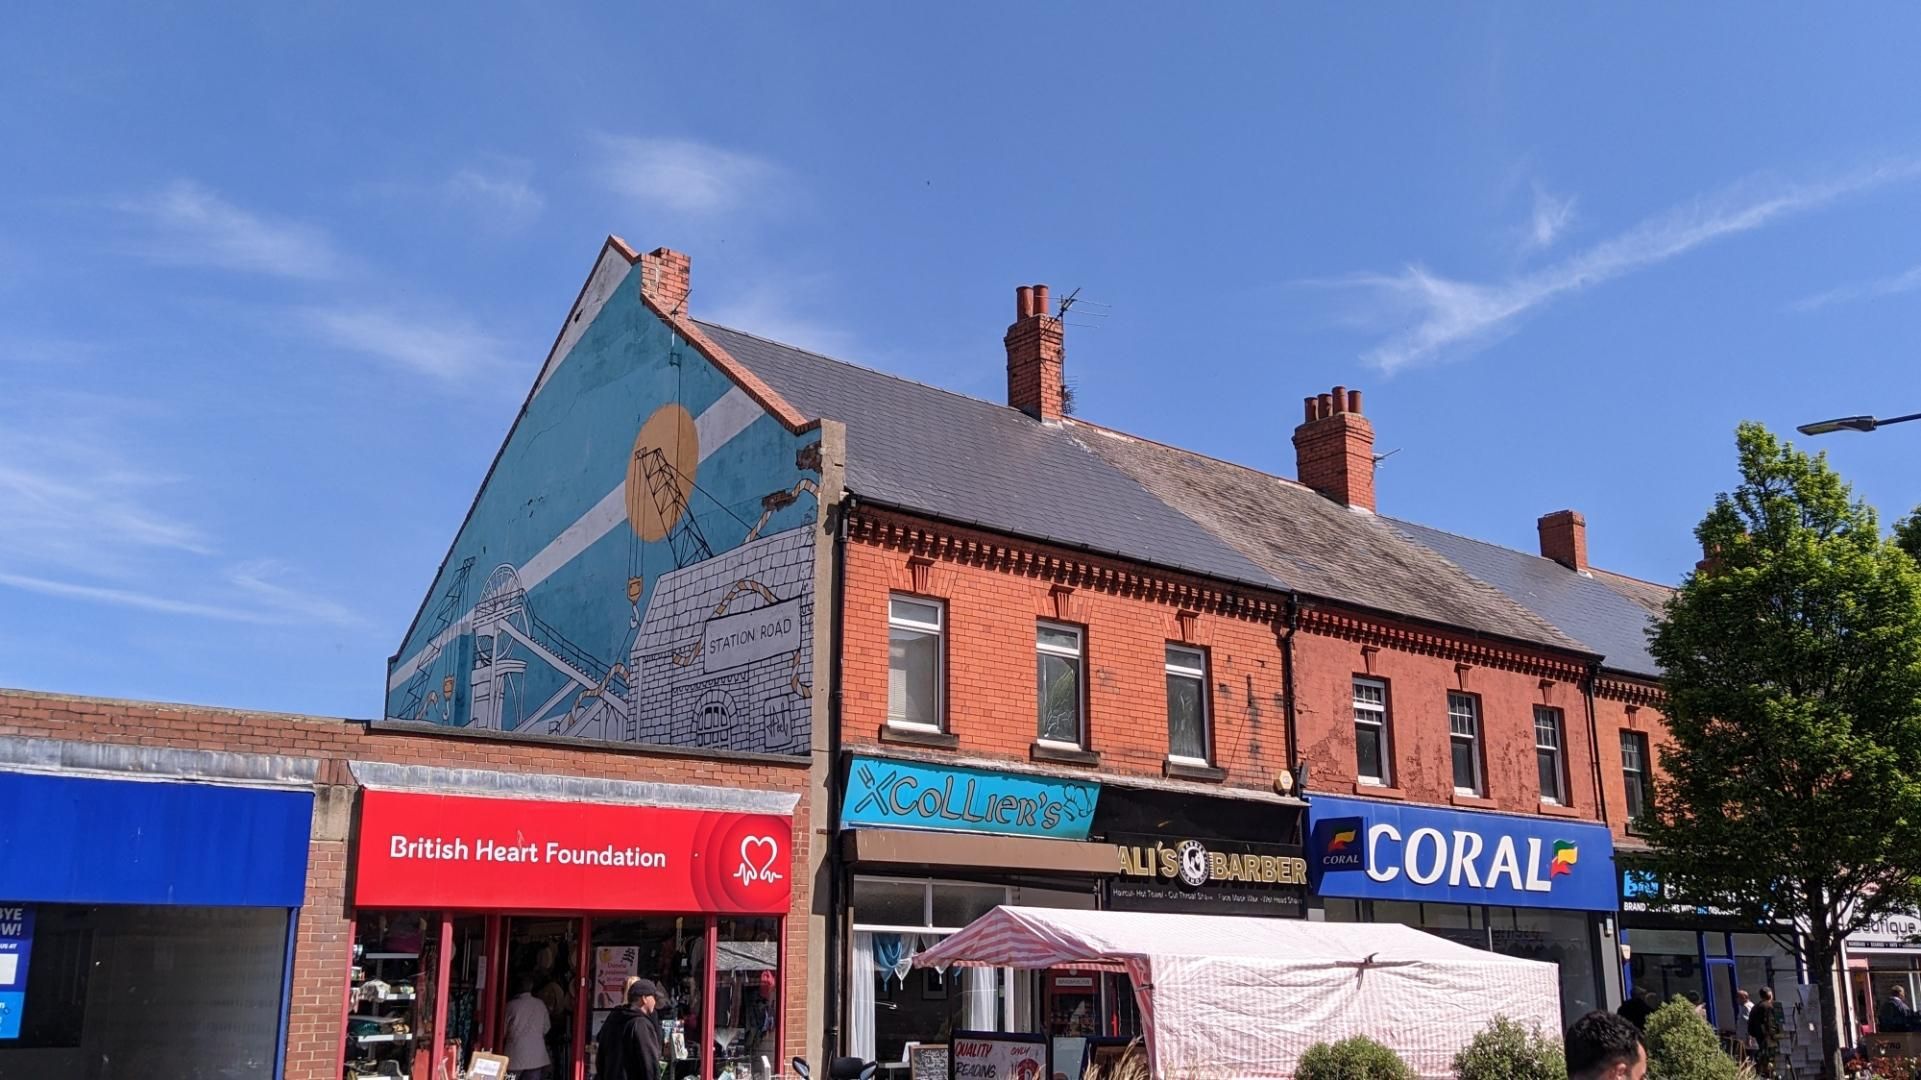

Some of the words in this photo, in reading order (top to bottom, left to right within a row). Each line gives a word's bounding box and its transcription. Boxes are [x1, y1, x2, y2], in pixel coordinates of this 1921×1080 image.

[709, 630, 755, 654] STATION
[761, 618, 792, 639] ROAD
[390, 835, 469, 860] British
[475, 838, 539, 863] Heart
[546, 842, 666, 868] Foundation
[1323, 854, 1360, 865] CORAL
[1367, 823, 1552, 892] CORAL
[1118, 841, 1180, 878] ALI'S
[1210, 851, 1308, 885] BARBER
[1623, 901, 1646, 912] BRAND
[955, 1041, 993, 1057] QUALITY
[1010, 1046, 1031, 1056] ONLY
[955, 1061, 997, 1078] READING
